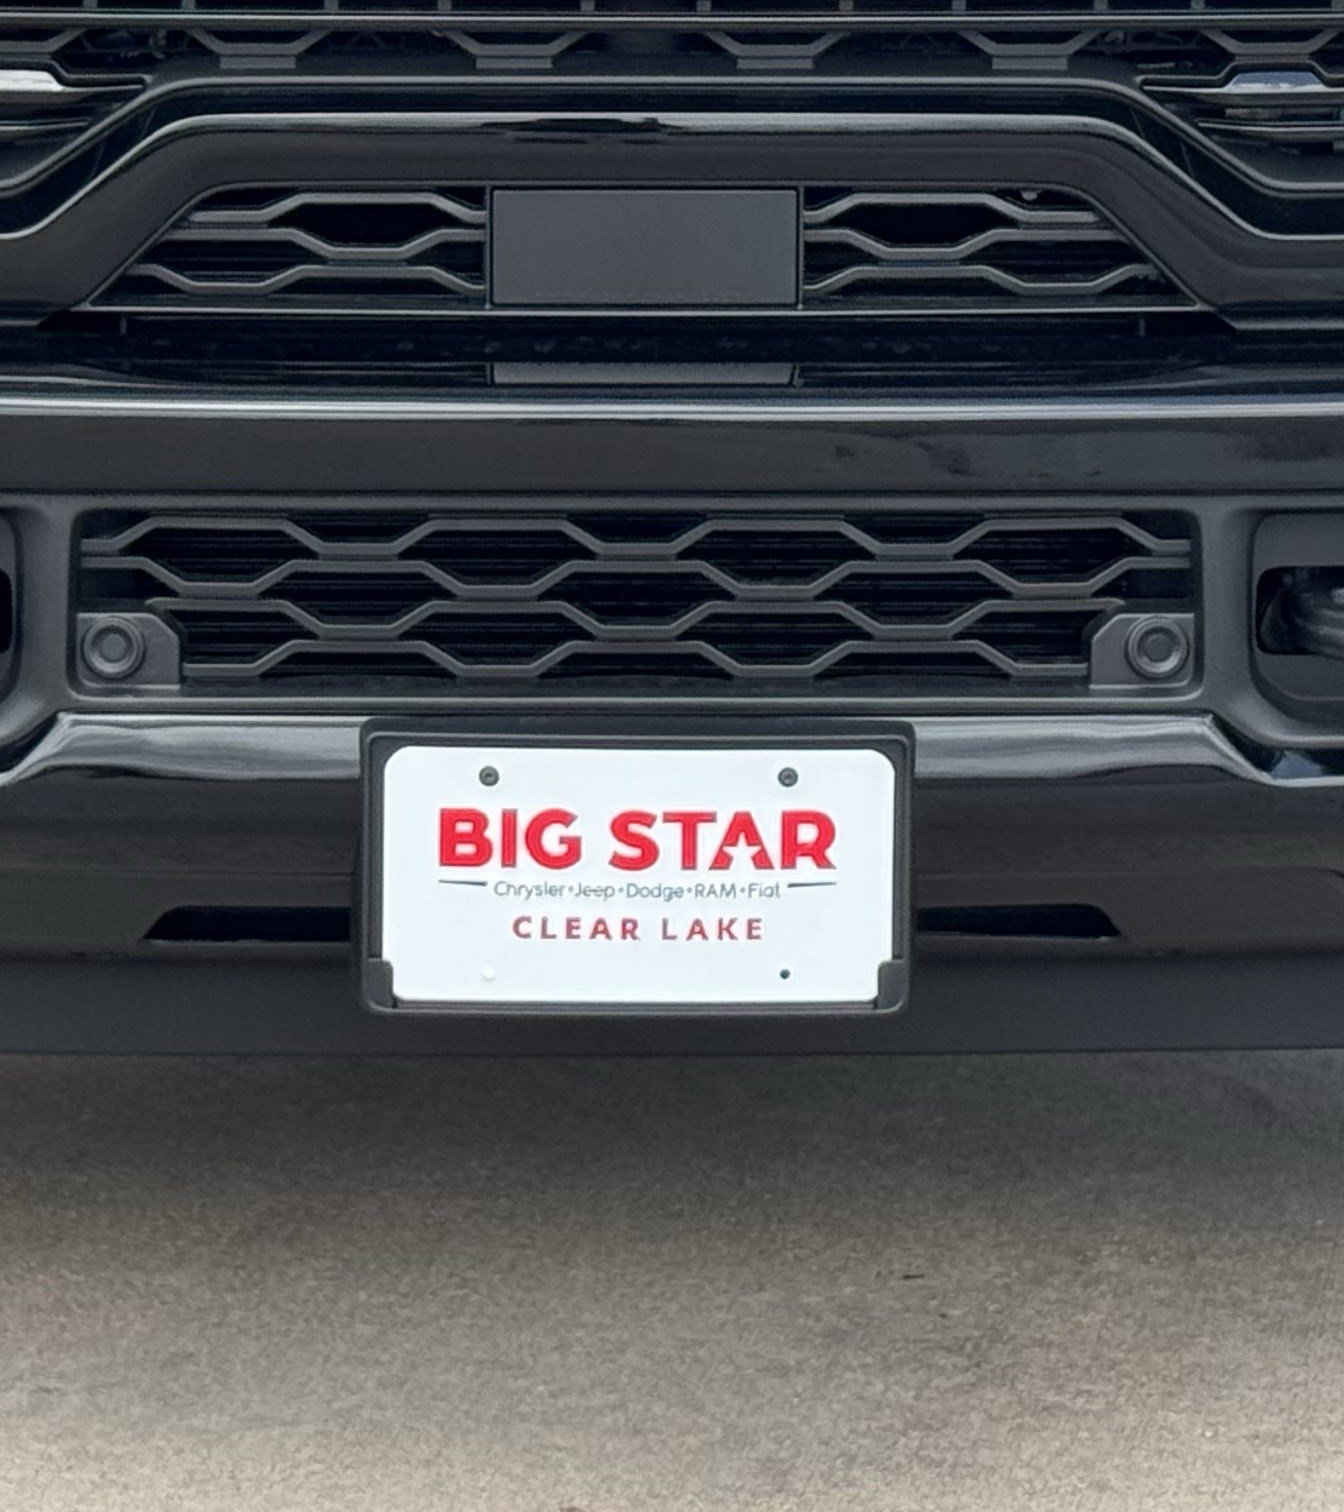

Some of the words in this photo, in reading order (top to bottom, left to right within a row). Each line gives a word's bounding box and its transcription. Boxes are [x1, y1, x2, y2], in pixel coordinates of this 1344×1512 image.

[438, 807, 582, 870] BIG
[608, 809, 837, 871] STAR
[494, 880, 564, 900] Chrysler
[574, 882, 616, 901] Jeep
[626, 882, 684, 902] Dodge
[694, 883, 737, 899] RAM
[747, 882, 781, 899] Fiat
[512, 916, 640, 941] CLEAR
[661, 917, 763, 941] LAKE
